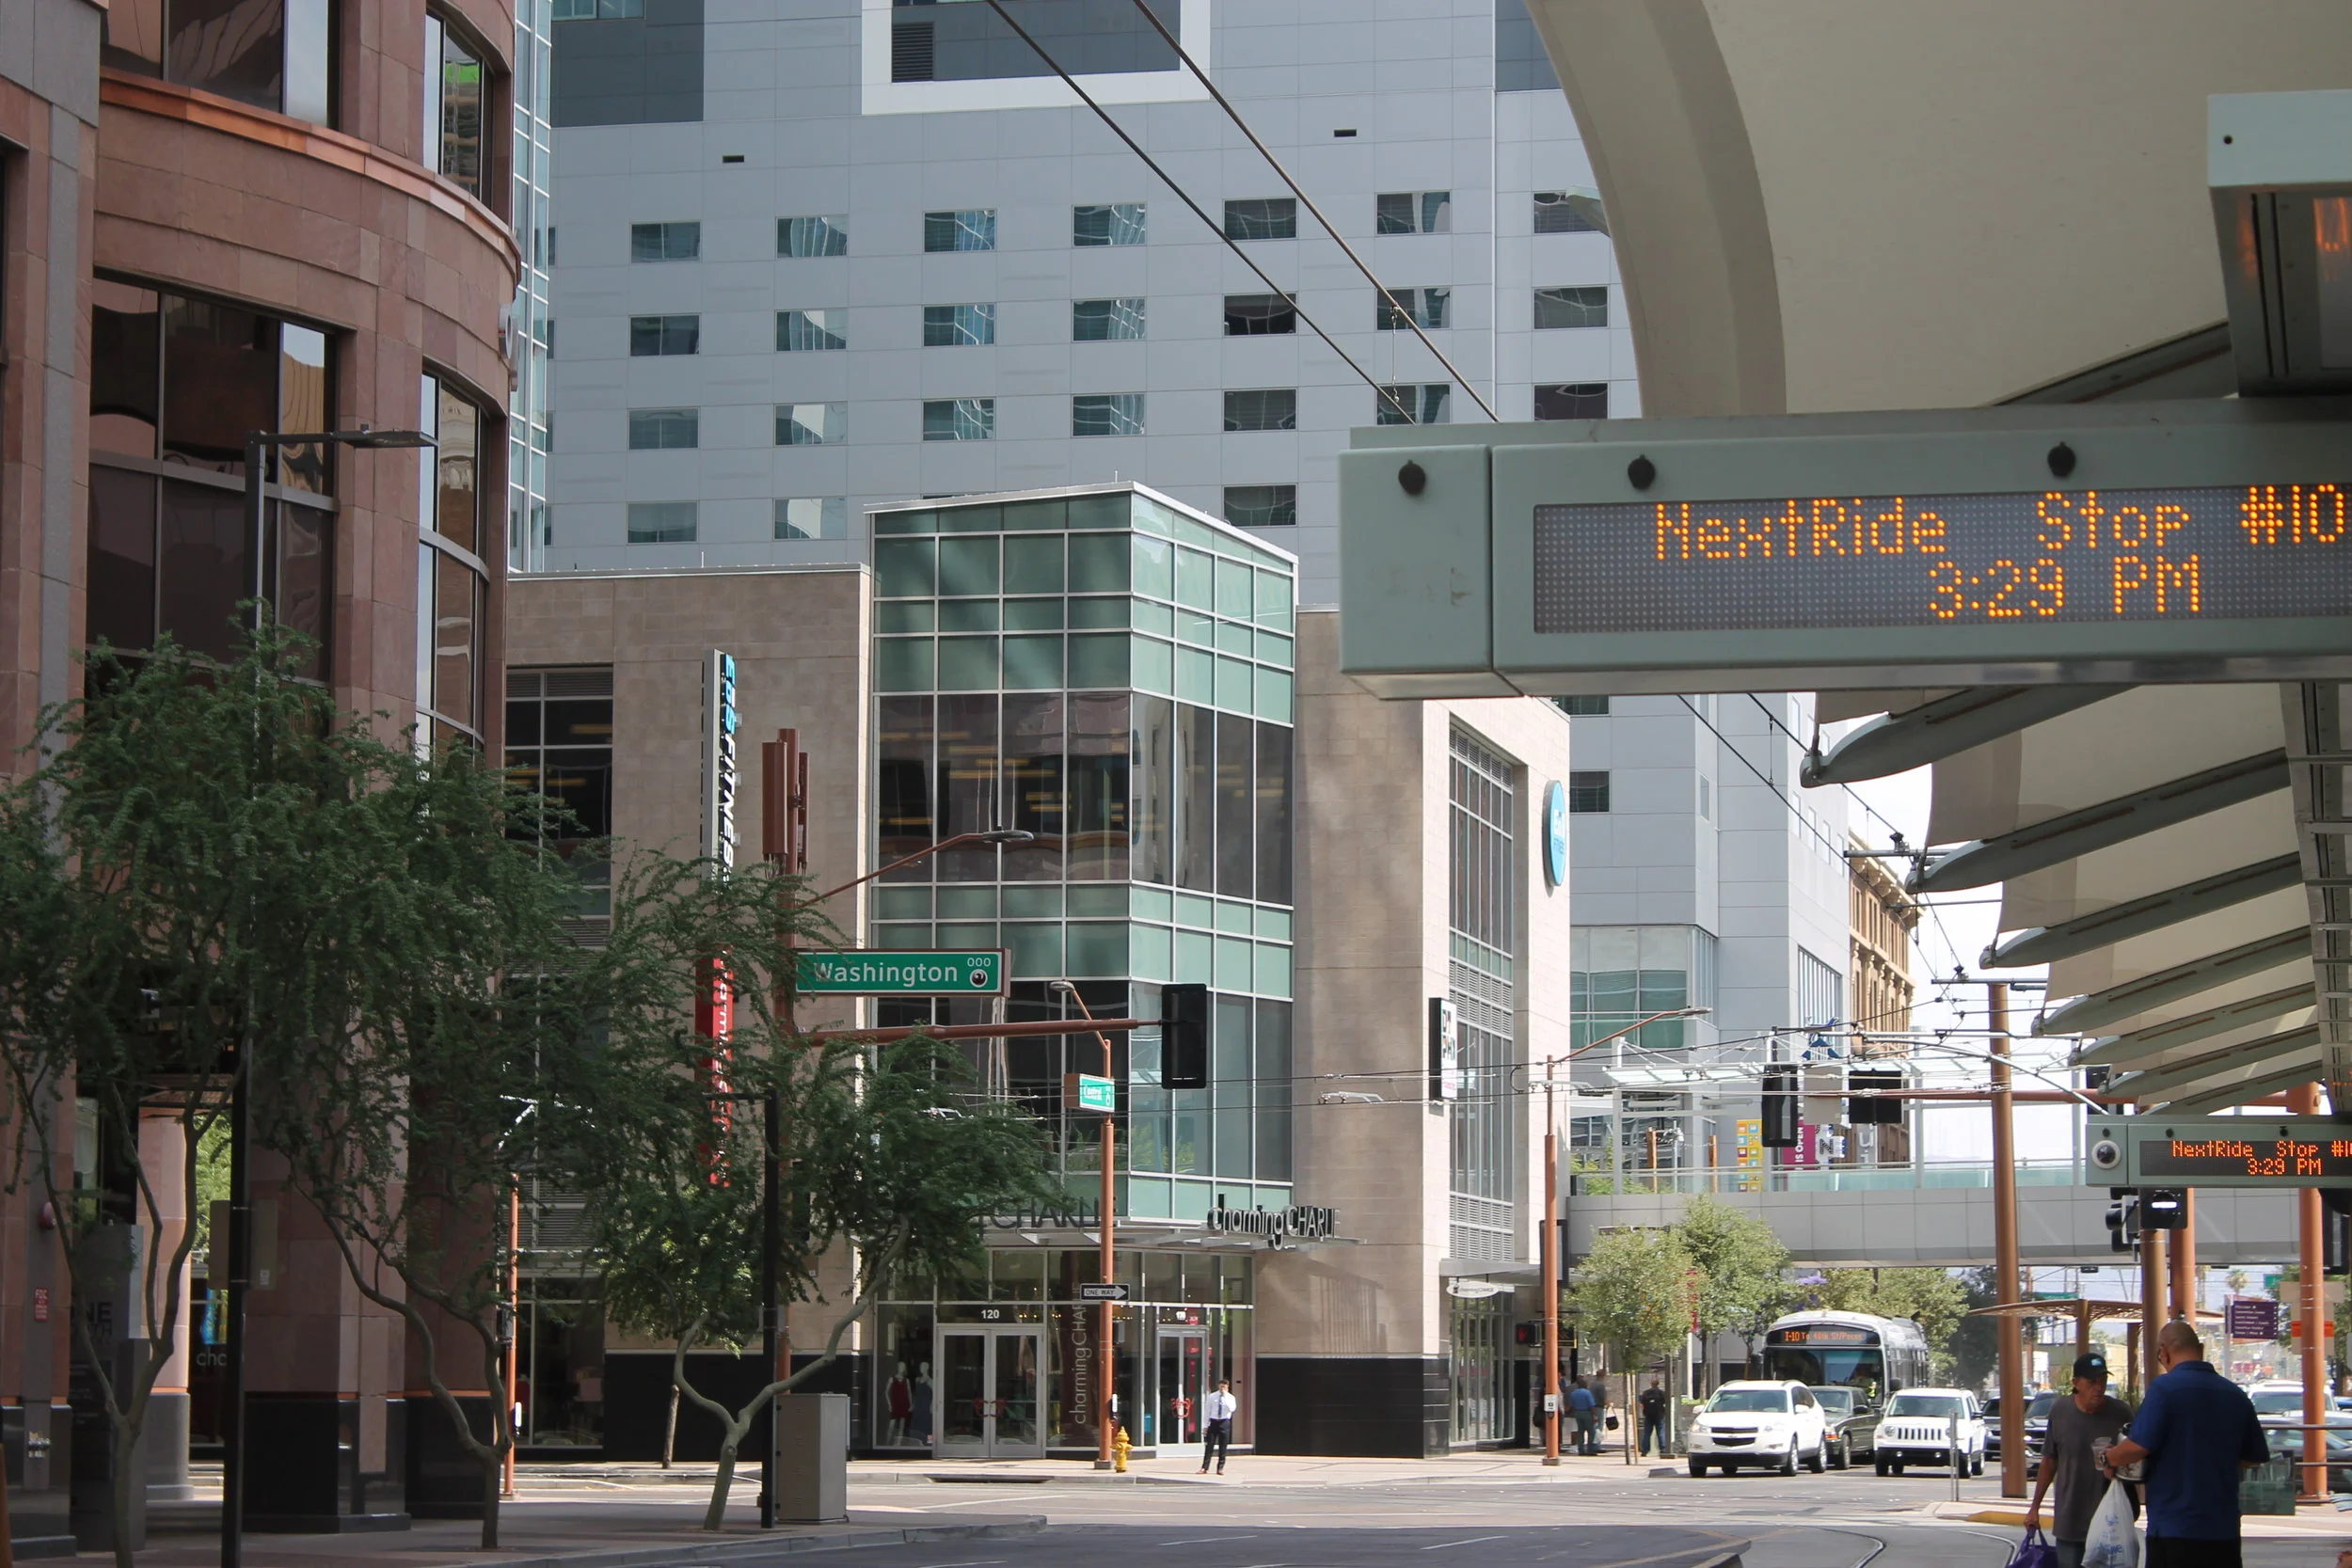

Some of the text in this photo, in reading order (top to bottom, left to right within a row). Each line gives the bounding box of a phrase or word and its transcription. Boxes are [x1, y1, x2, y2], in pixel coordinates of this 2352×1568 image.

[1657, 483, 2344, 560] NextRide Stop #10
[1930, 554, 2200, 618] 3:29 PM
[813, 961, 958, 988] Washington
[2171, 1140, 2253, 1157] NextRide
[2276, 1139, 2318, 1157] Stop
[2248, 1158, 2322, 1175] 3:29 PM
[980, 1309, 1000, 1319] 120
